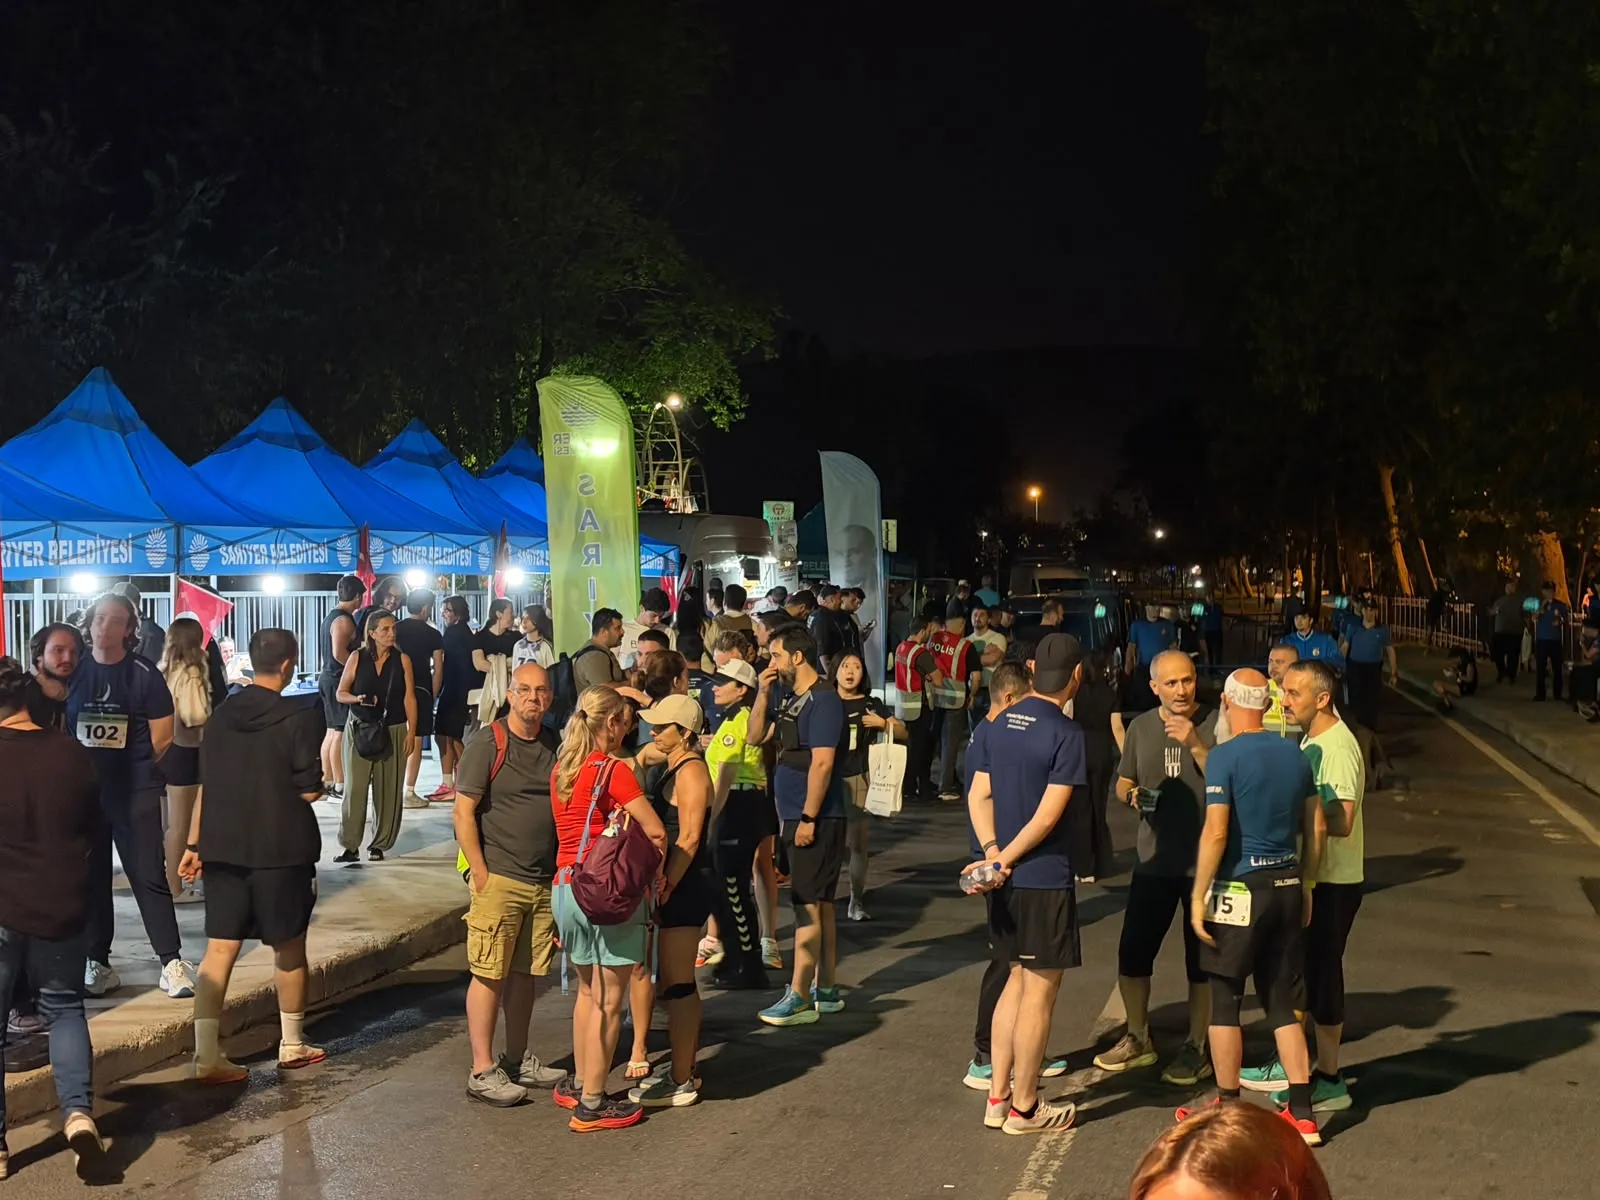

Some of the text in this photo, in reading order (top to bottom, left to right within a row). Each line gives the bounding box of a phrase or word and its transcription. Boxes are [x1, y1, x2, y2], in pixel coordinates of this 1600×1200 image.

[48, 534, 132, 565] BELEDİYESİ
[219, 543, 268, 566] SARIYER
[392, 545, 427, 565] SARIYER
[84, 724, 119, 741] 102
